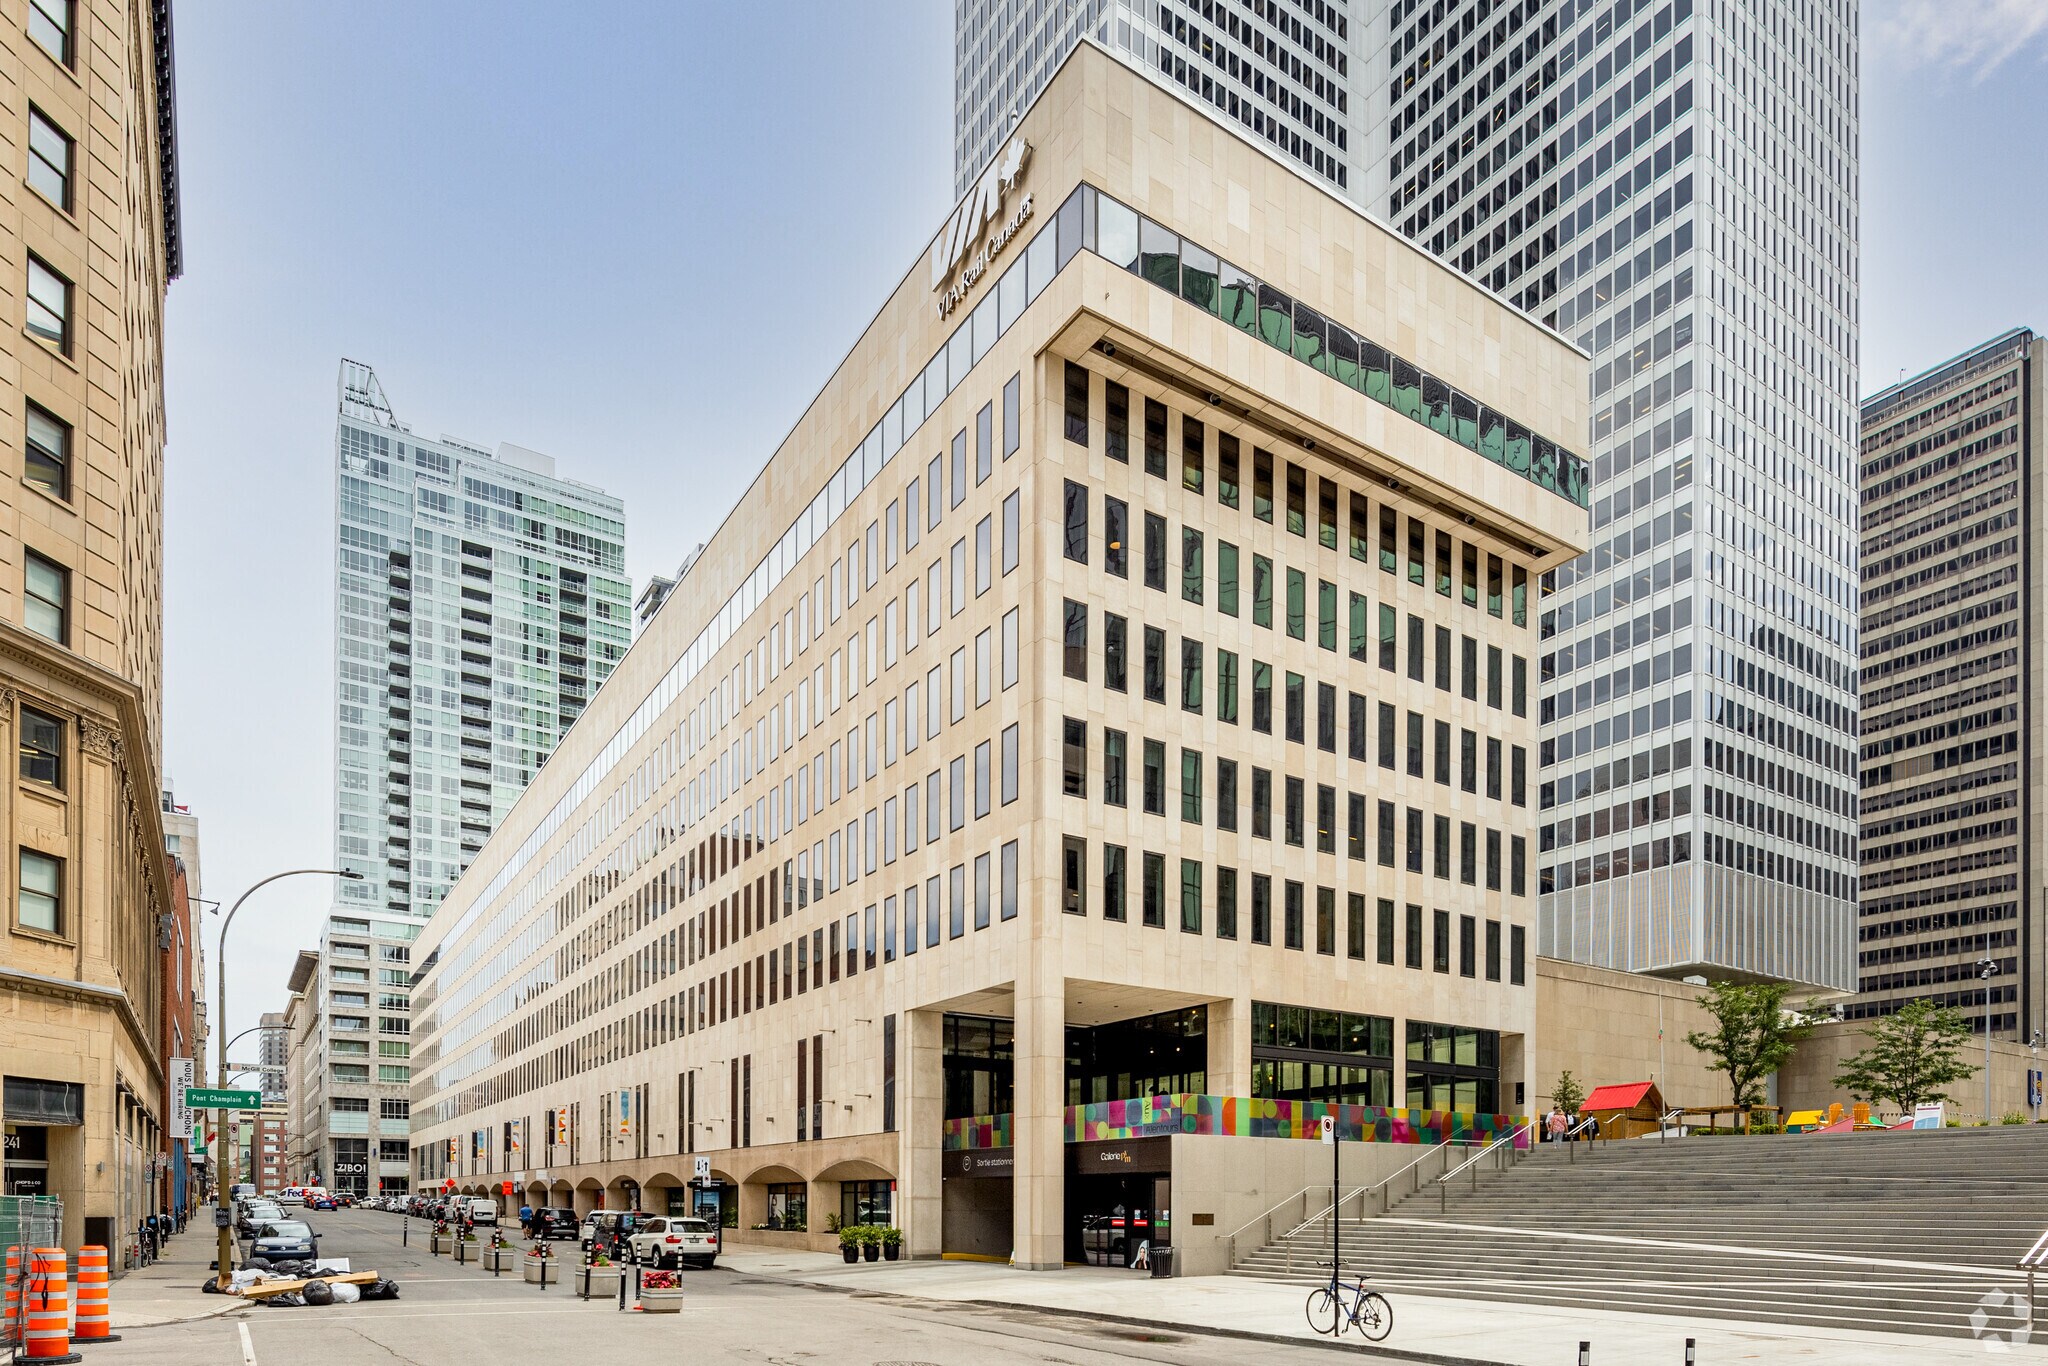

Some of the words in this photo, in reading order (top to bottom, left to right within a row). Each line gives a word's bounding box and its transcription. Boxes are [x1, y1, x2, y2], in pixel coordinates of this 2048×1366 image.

[936, 284, 962, 321] VIA
[961, 251, 987, 294] Rail
[985, 193, 1034, 262] Canada
[184, 1062, 192, 1083] NOUS
[192, 1094, 206, 1102] Pont
[209, 1095, 242, 1103] Champlain
[1145, 1124, 1179, 1133] Alentours
[1100, 1152, 1120, 1160] Galerie
[977, 1159, 990, 1167] Sortie
[287, 1188, 315, 1197] FedEx
